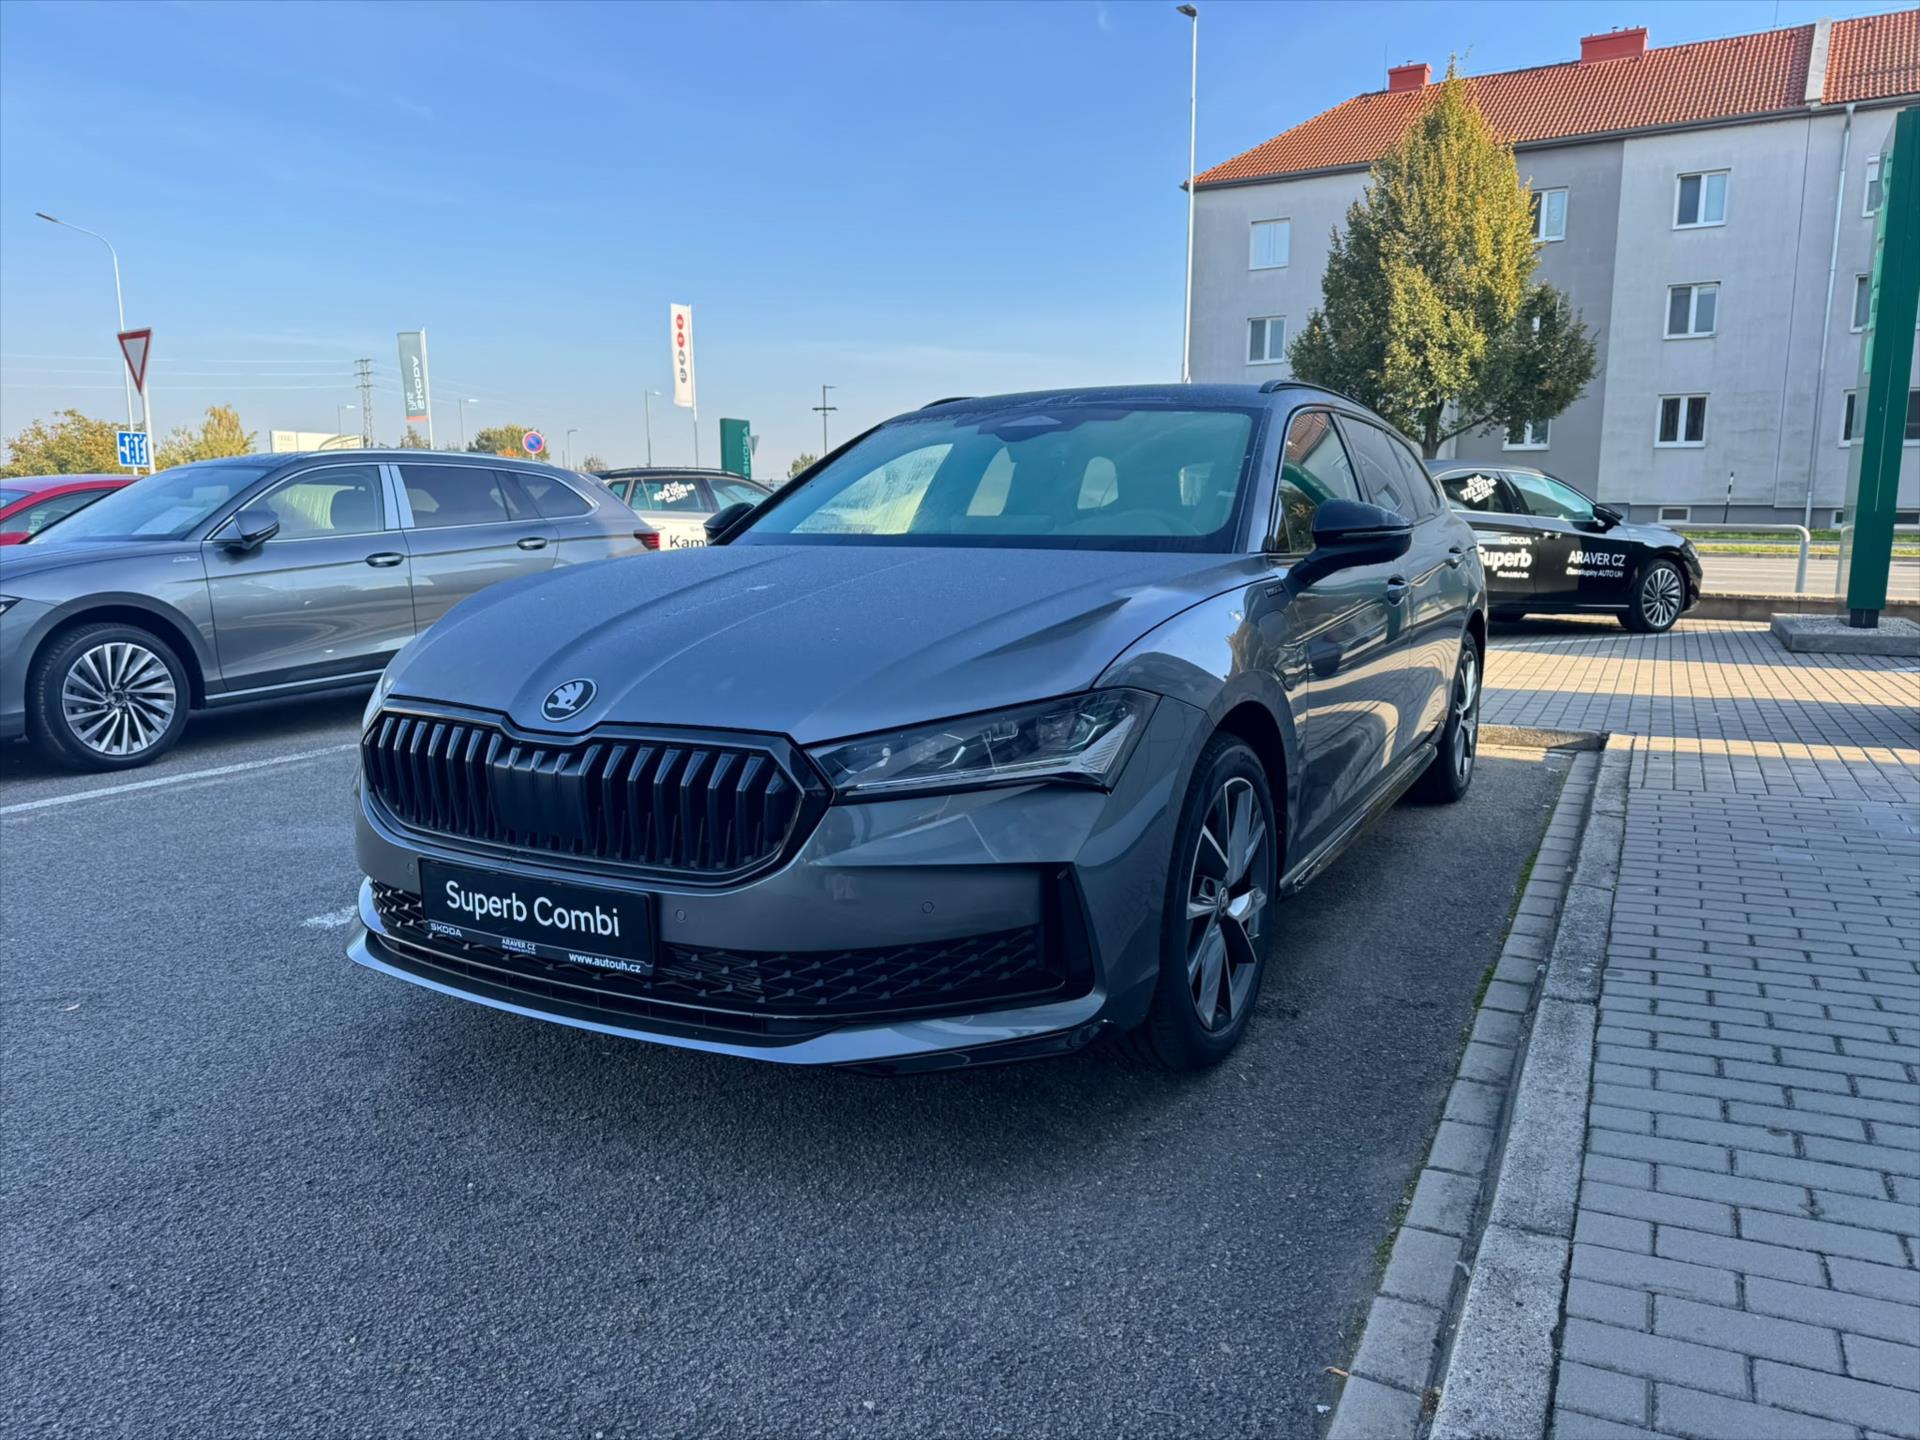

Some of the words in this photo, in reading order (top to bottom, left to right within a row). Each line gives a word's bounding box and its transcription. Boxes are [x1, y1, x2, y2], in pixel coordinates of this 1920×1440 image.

[1568, 550, 1610, 566] ARAVER
[1611, 553, 1626, 567] CZ
[445, 880, 528, 922] Superb
[533, 896, 620, 938] Combi
[502, 938, 526, 949] ARAVER
[526, 942, 537, 952] CZ
[568, 952, 642, 974] www.autouh.cz
